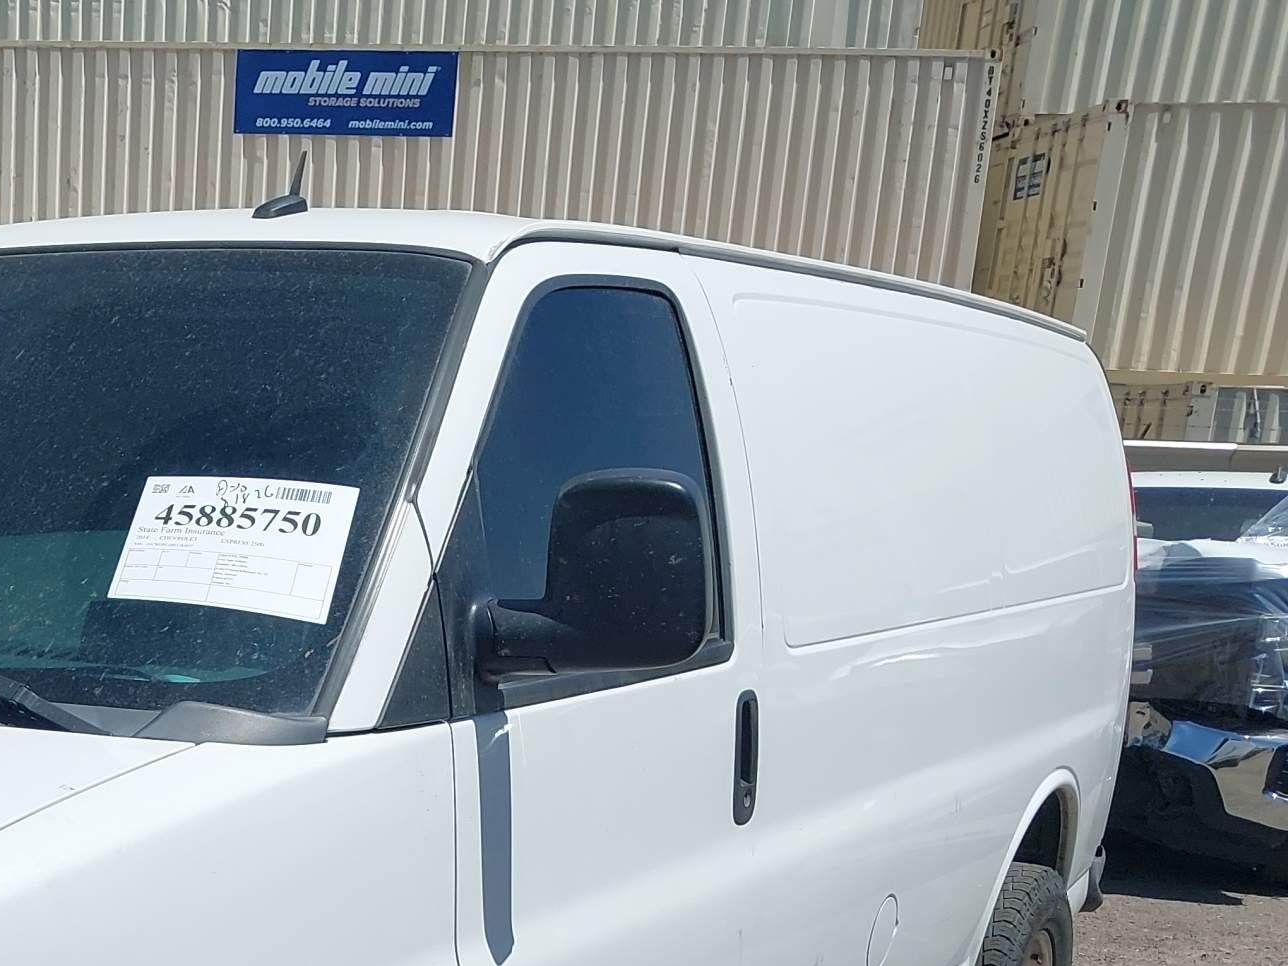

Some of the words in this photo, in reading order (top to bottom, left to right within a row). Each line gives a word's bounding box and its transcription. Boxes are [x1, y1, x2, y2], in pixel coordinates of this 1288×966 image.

[253, 59, 361, 95] mobile
[362, 66, 437, 96] mini
[308, 96, 358, 107] STORAGE
[360, 98, 421, 108] SOLUTIONS
[255, 117, 331, 128] 800.950.6464
[348, 119, 433, 130] mobilemini.com
[154, 502, 322, 537] 45885750
